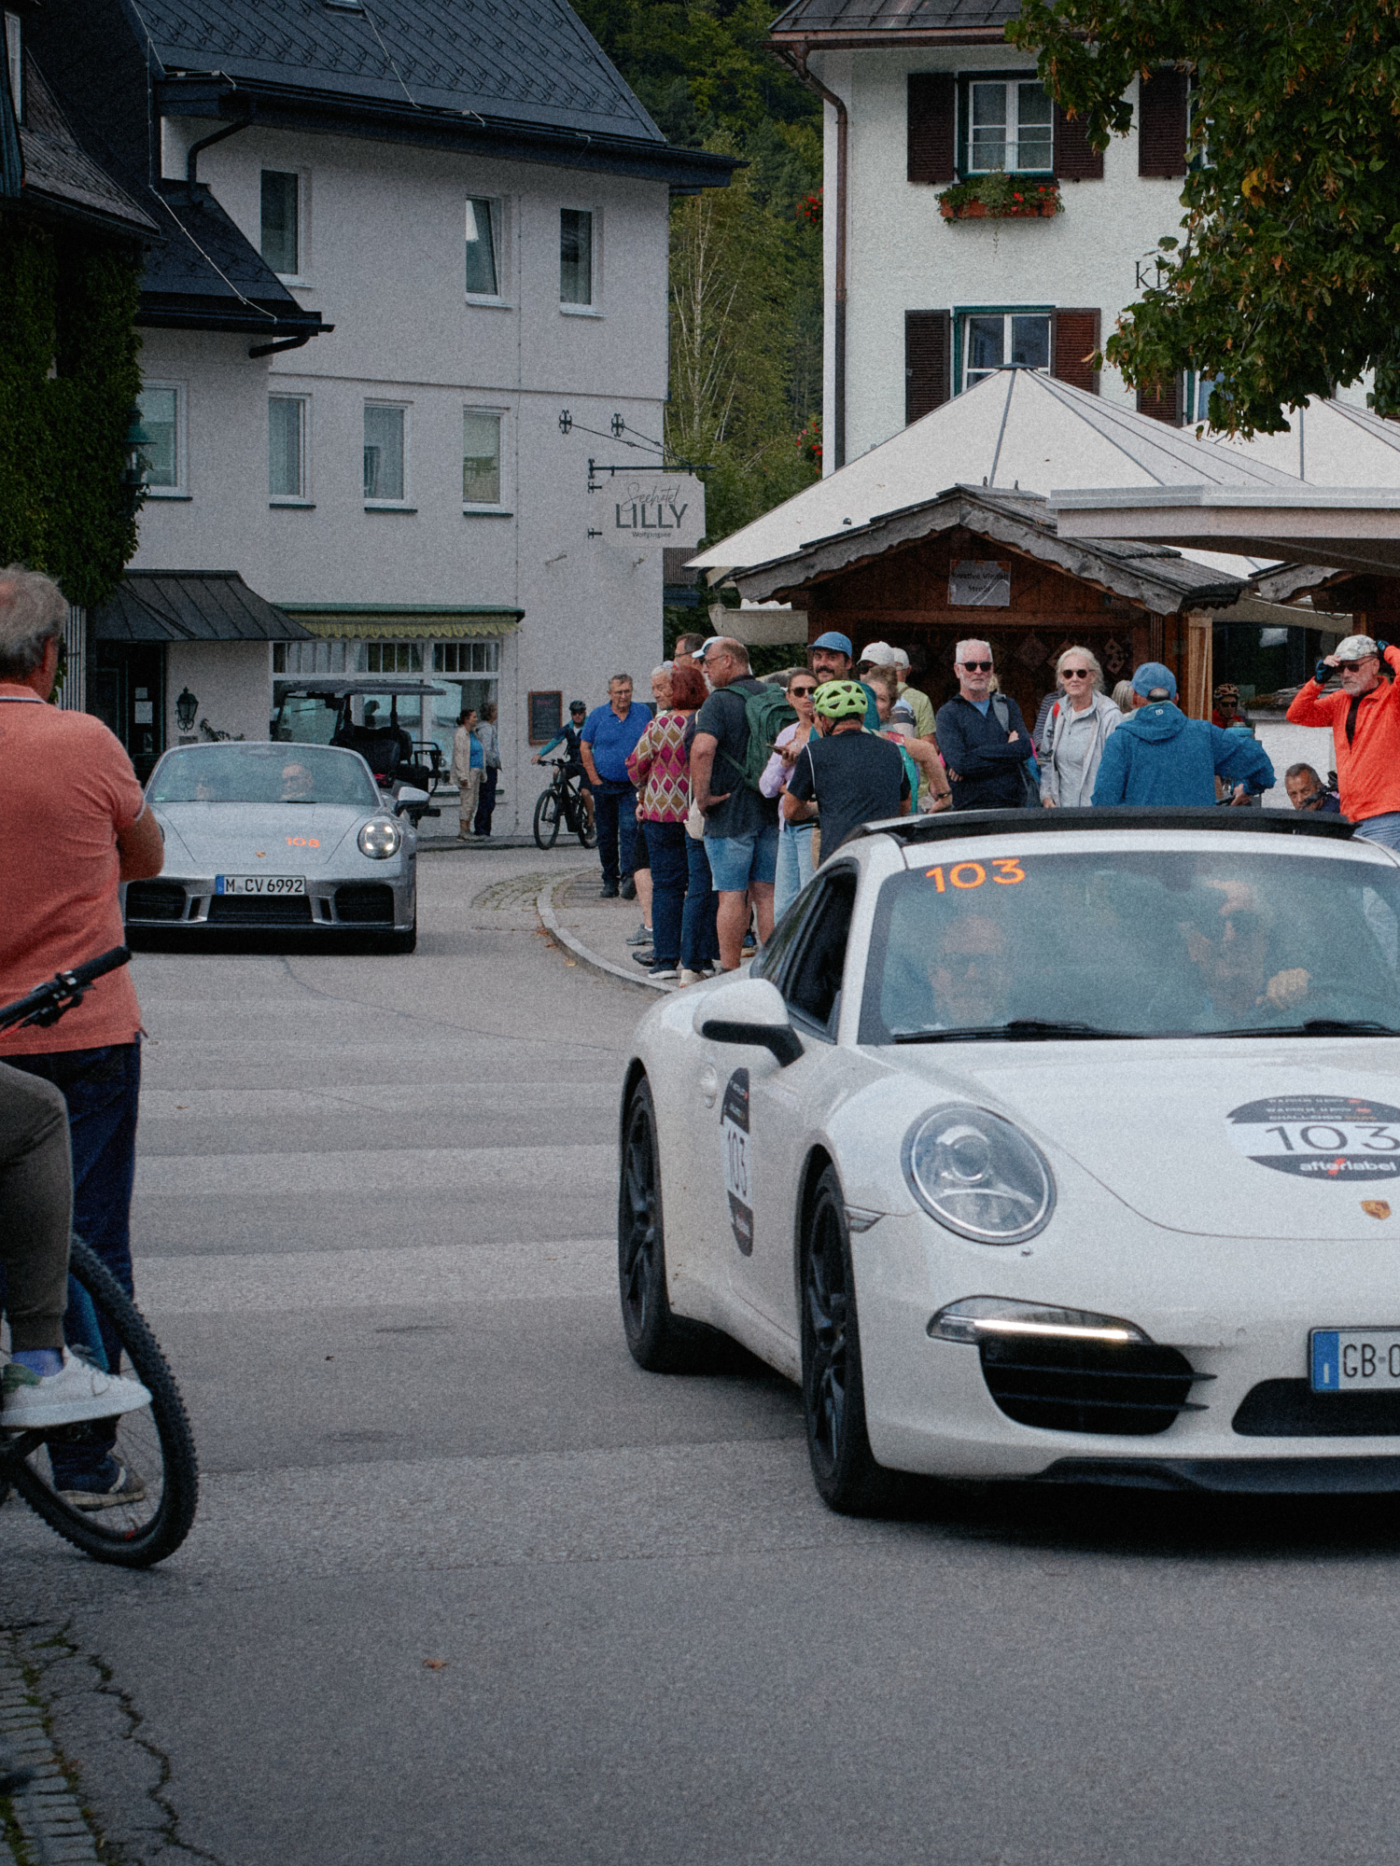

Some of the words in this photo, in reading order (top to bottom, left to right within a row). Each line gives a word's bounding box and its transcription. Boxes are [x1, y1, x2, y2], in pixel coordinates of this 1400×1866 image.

[621, 481, 680, 511] Seehotel
[615, 503, 688, 528] LILLY
[285, 837, 321, 849] 108
[225, 879, 236, 893] M
[244, 878, 264, 893] CV
[266, 878, 304, 893] 6992
[925, 858, 1026, 893] 103
[1299, 1159, 1398, 1173] afterlabel
